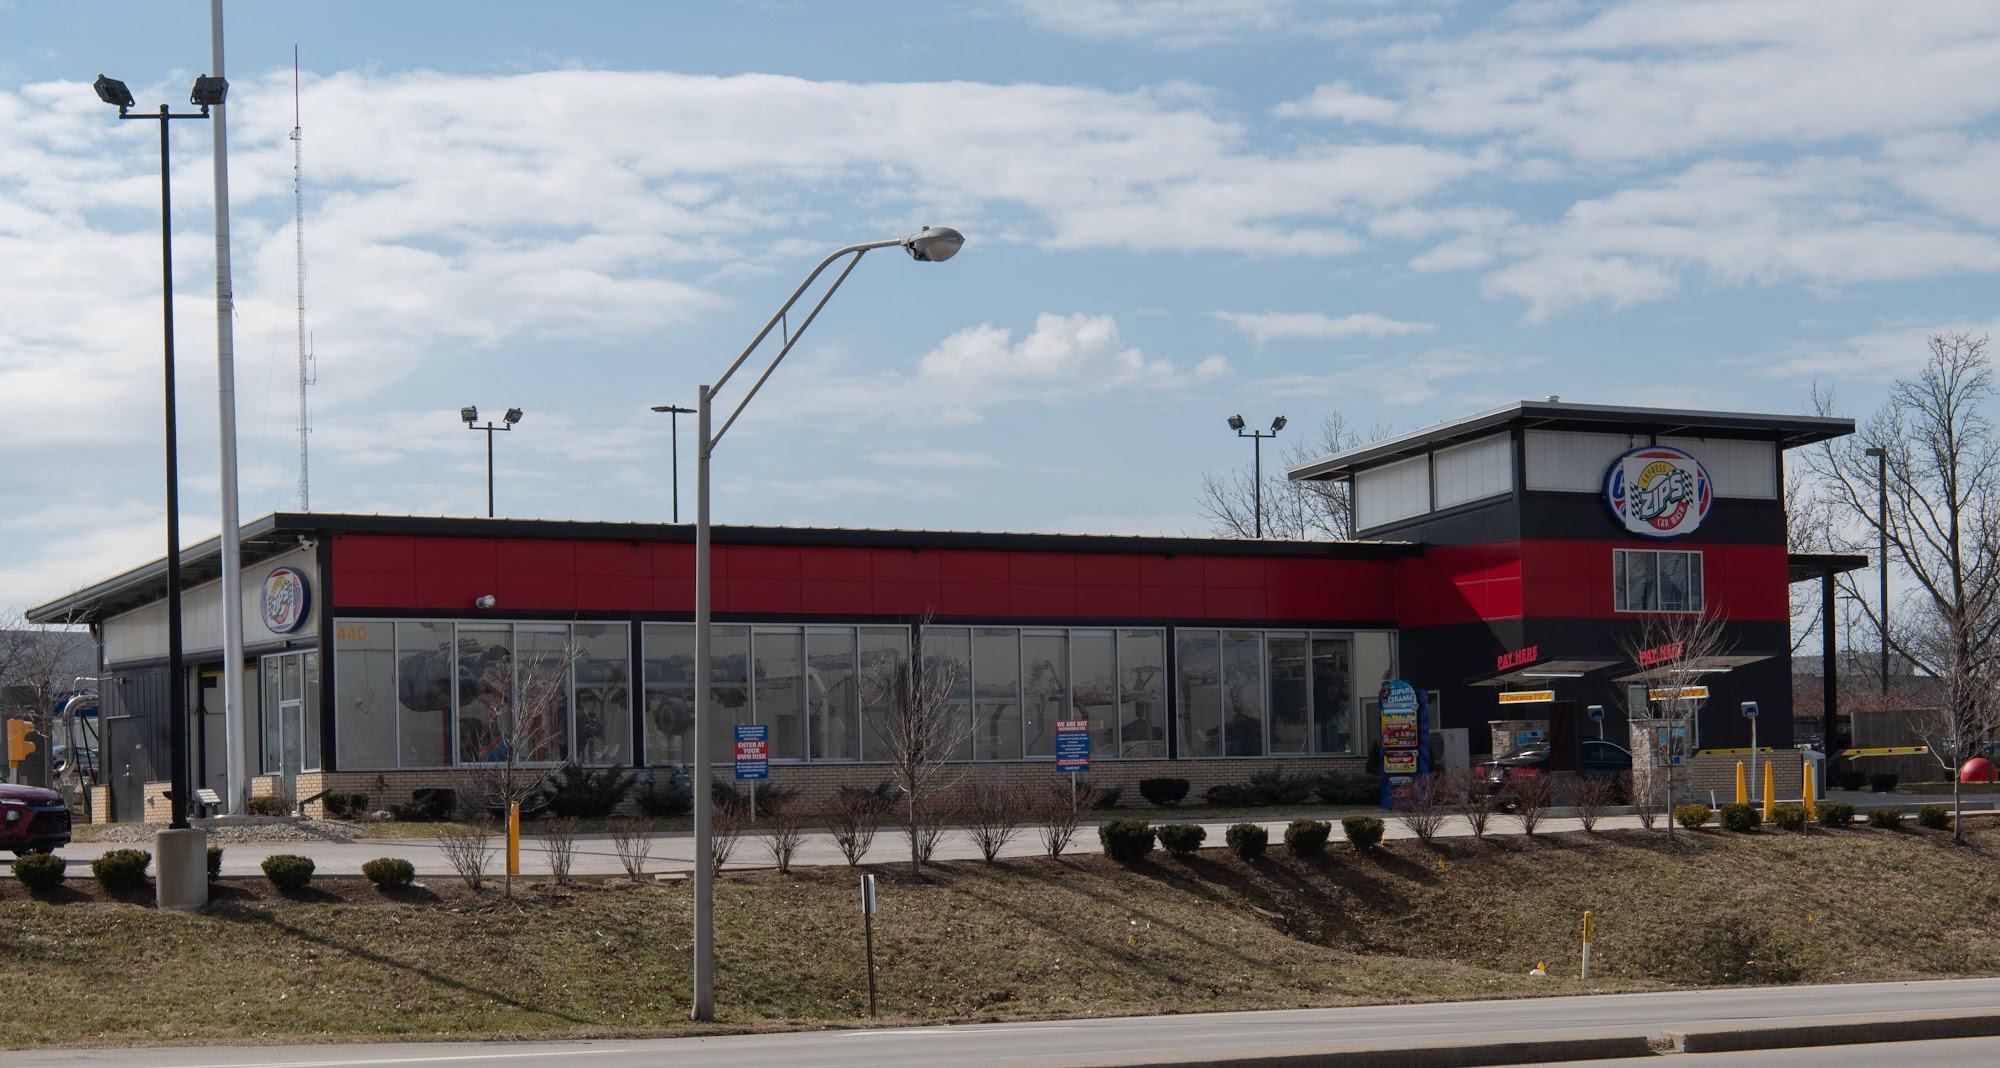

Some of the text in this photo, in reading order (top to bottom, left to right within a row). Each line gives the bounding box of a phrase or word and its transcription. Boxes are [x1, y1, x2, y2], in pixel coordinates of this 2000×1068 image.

[1641, 464, 1666, 483] EXPRESS
[1640, 472, 1684, 518] ZIPS
[1657, 506, 1685, 528] CAR WASH
[337, 624, 367, 640] 440
[1497, 645, 1538, 670] PAY HERE
[1640, 648, 1657, 666] PAY
[1390, 687, 1410, 696] SUPER
